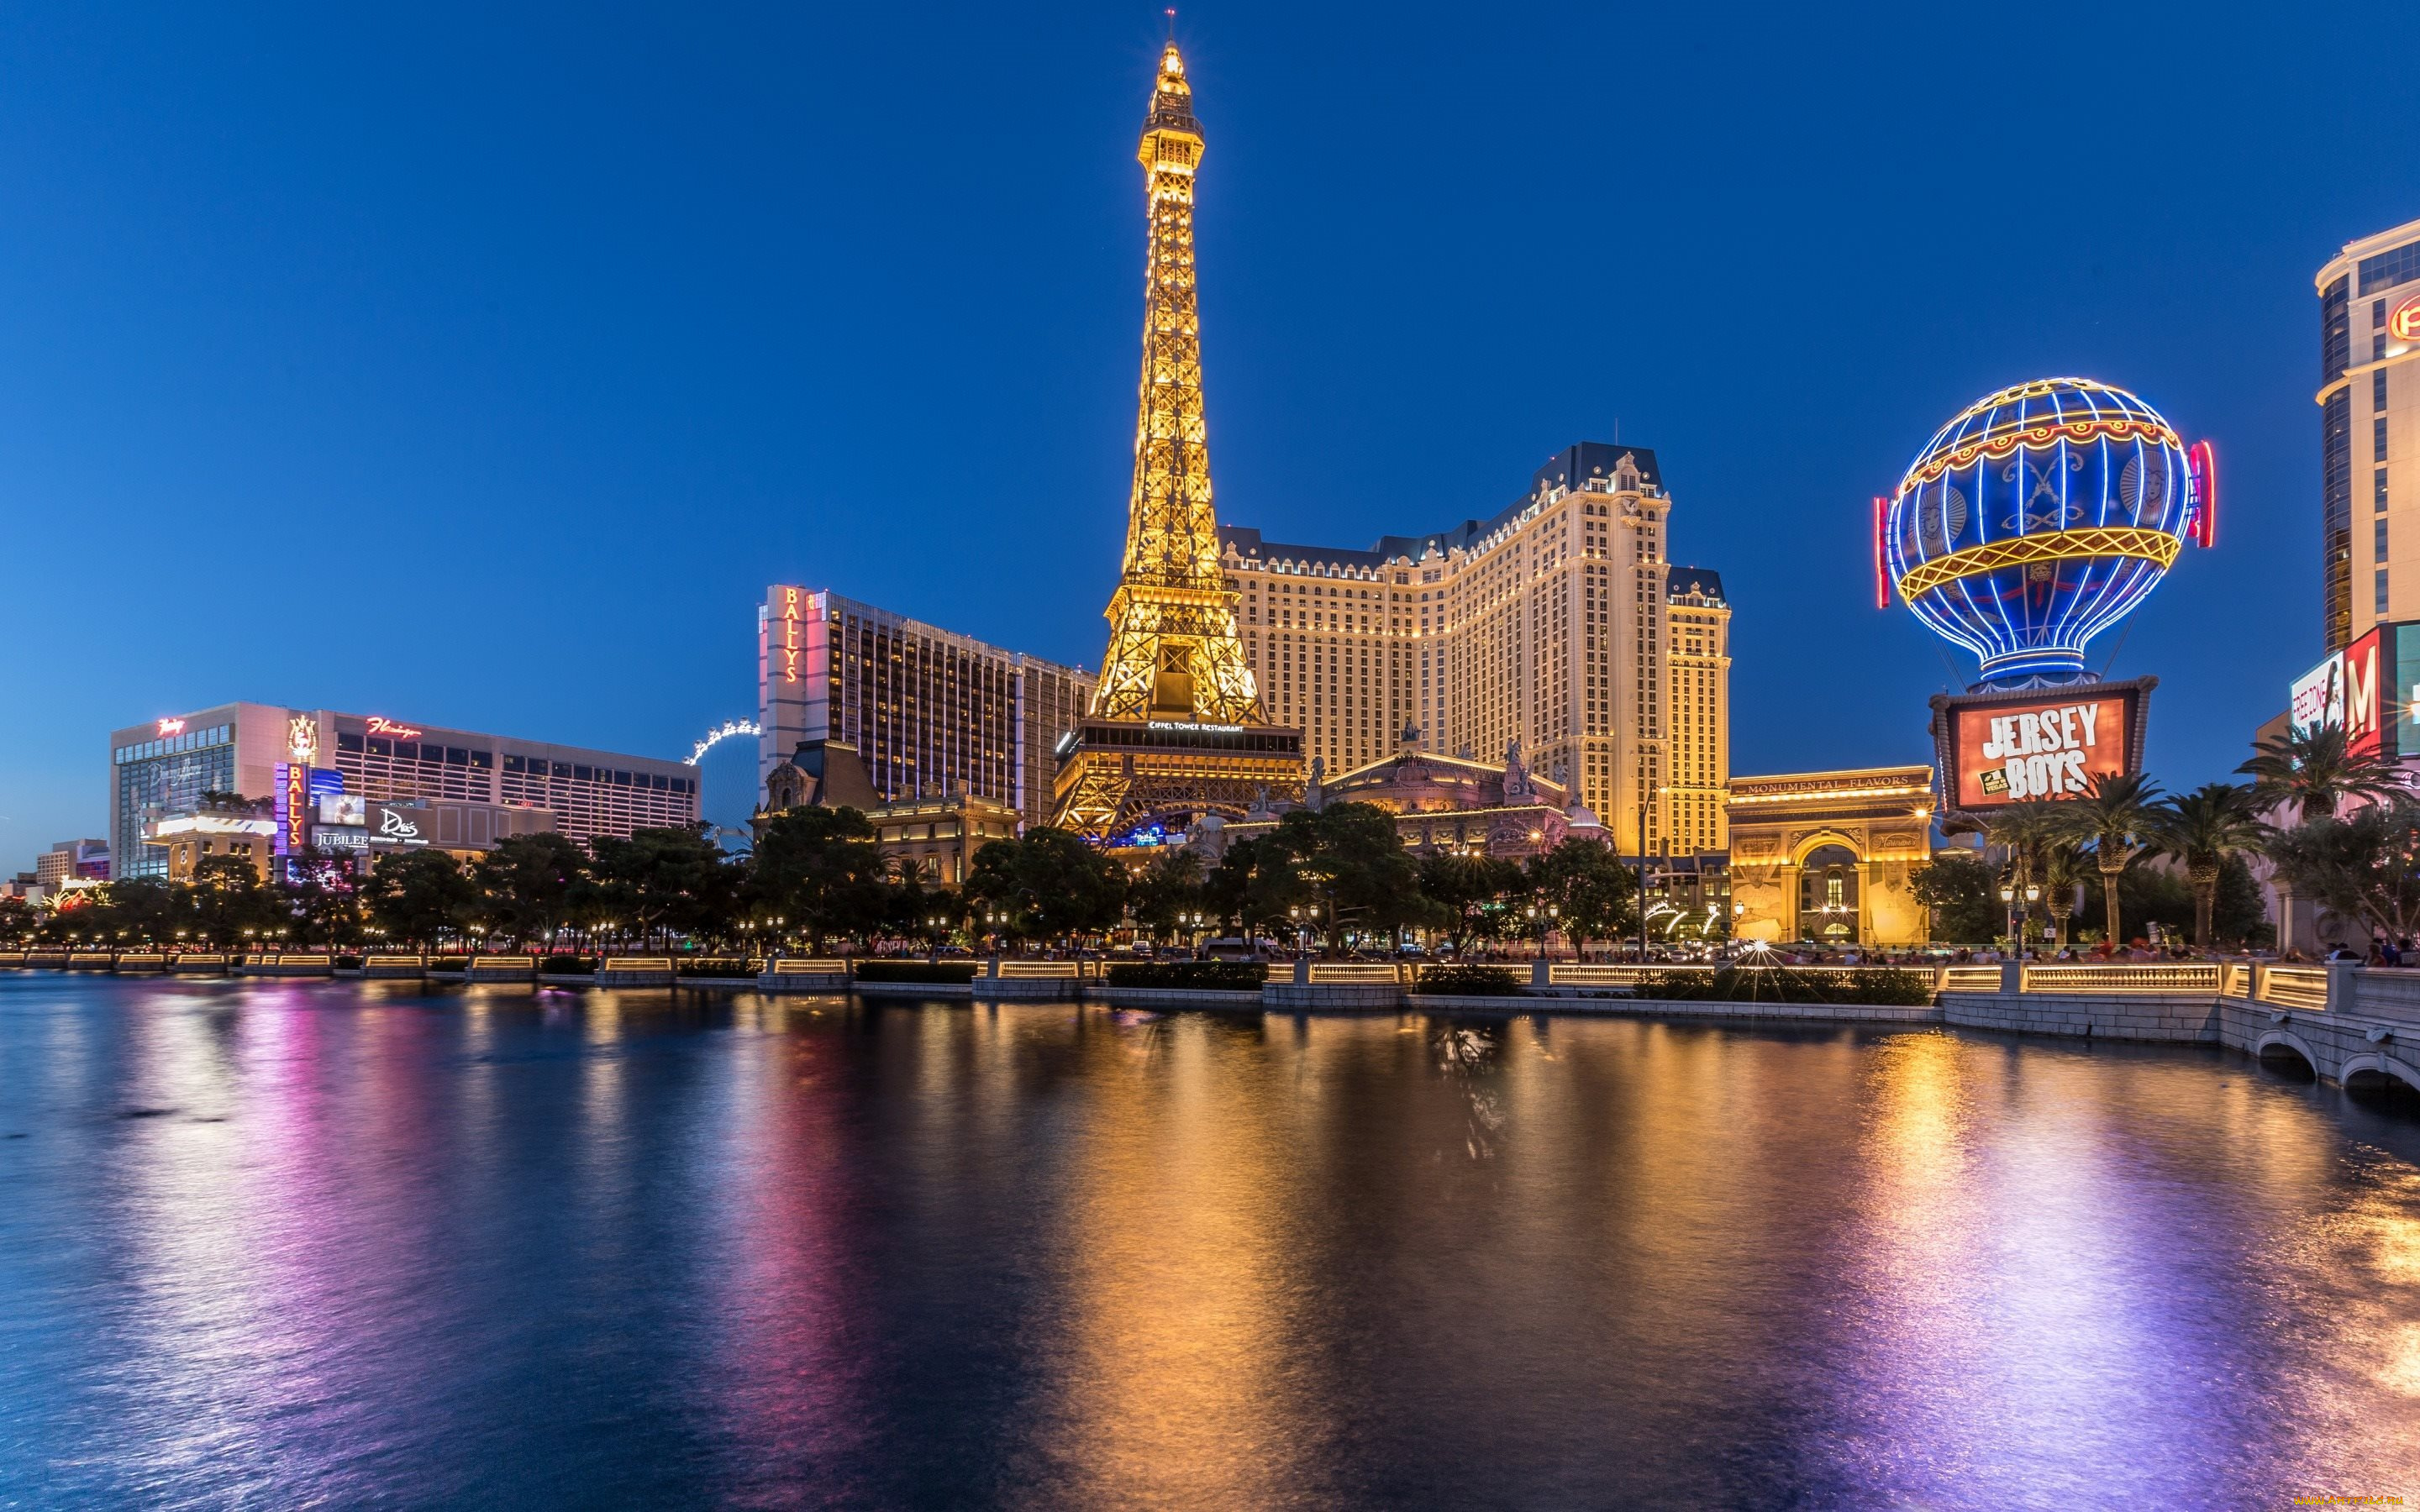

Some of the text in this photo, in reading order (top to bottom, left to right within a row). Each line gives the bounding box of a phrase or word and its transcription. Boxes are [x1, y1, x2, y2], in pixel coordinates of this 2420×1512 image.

[784, 588, 799, 683] BALLYS
[1983, 703, 2098, 759] JERSEY
[1748, 775, 1909, 794] MONUMENTAL FLAVORS
[2006, 749, 2088, 798] BOYS
[288, 766, 302, 845] BALLYS
